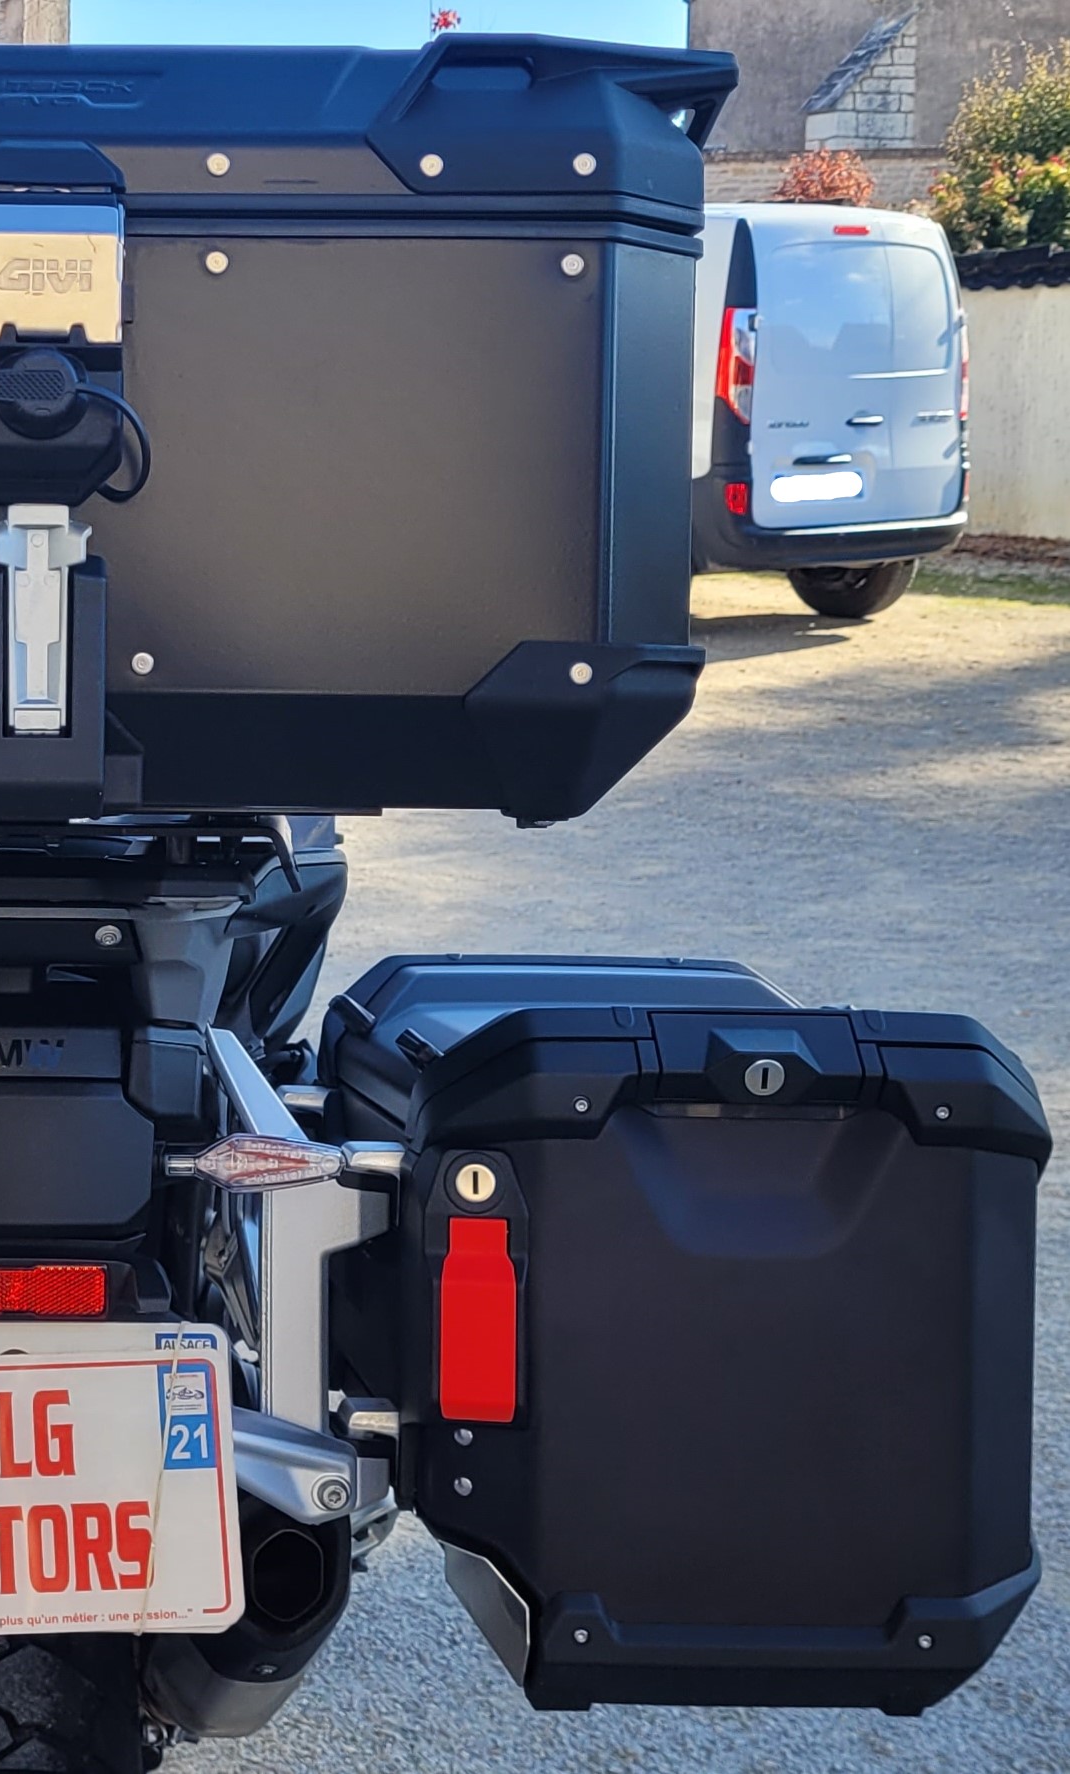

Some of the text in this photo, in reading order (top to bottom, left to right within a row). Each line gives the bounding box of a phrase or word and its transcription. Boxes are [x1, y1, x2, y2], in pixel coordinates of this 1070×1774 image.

[170, 1423, 209, 1460] 21
[0, 1615, 24, 1630] plus
[27, 1613, 60, 1627] qu'un
[62, 1612, 99, 1623] métier
[108, 1612, 130, 1622] une
